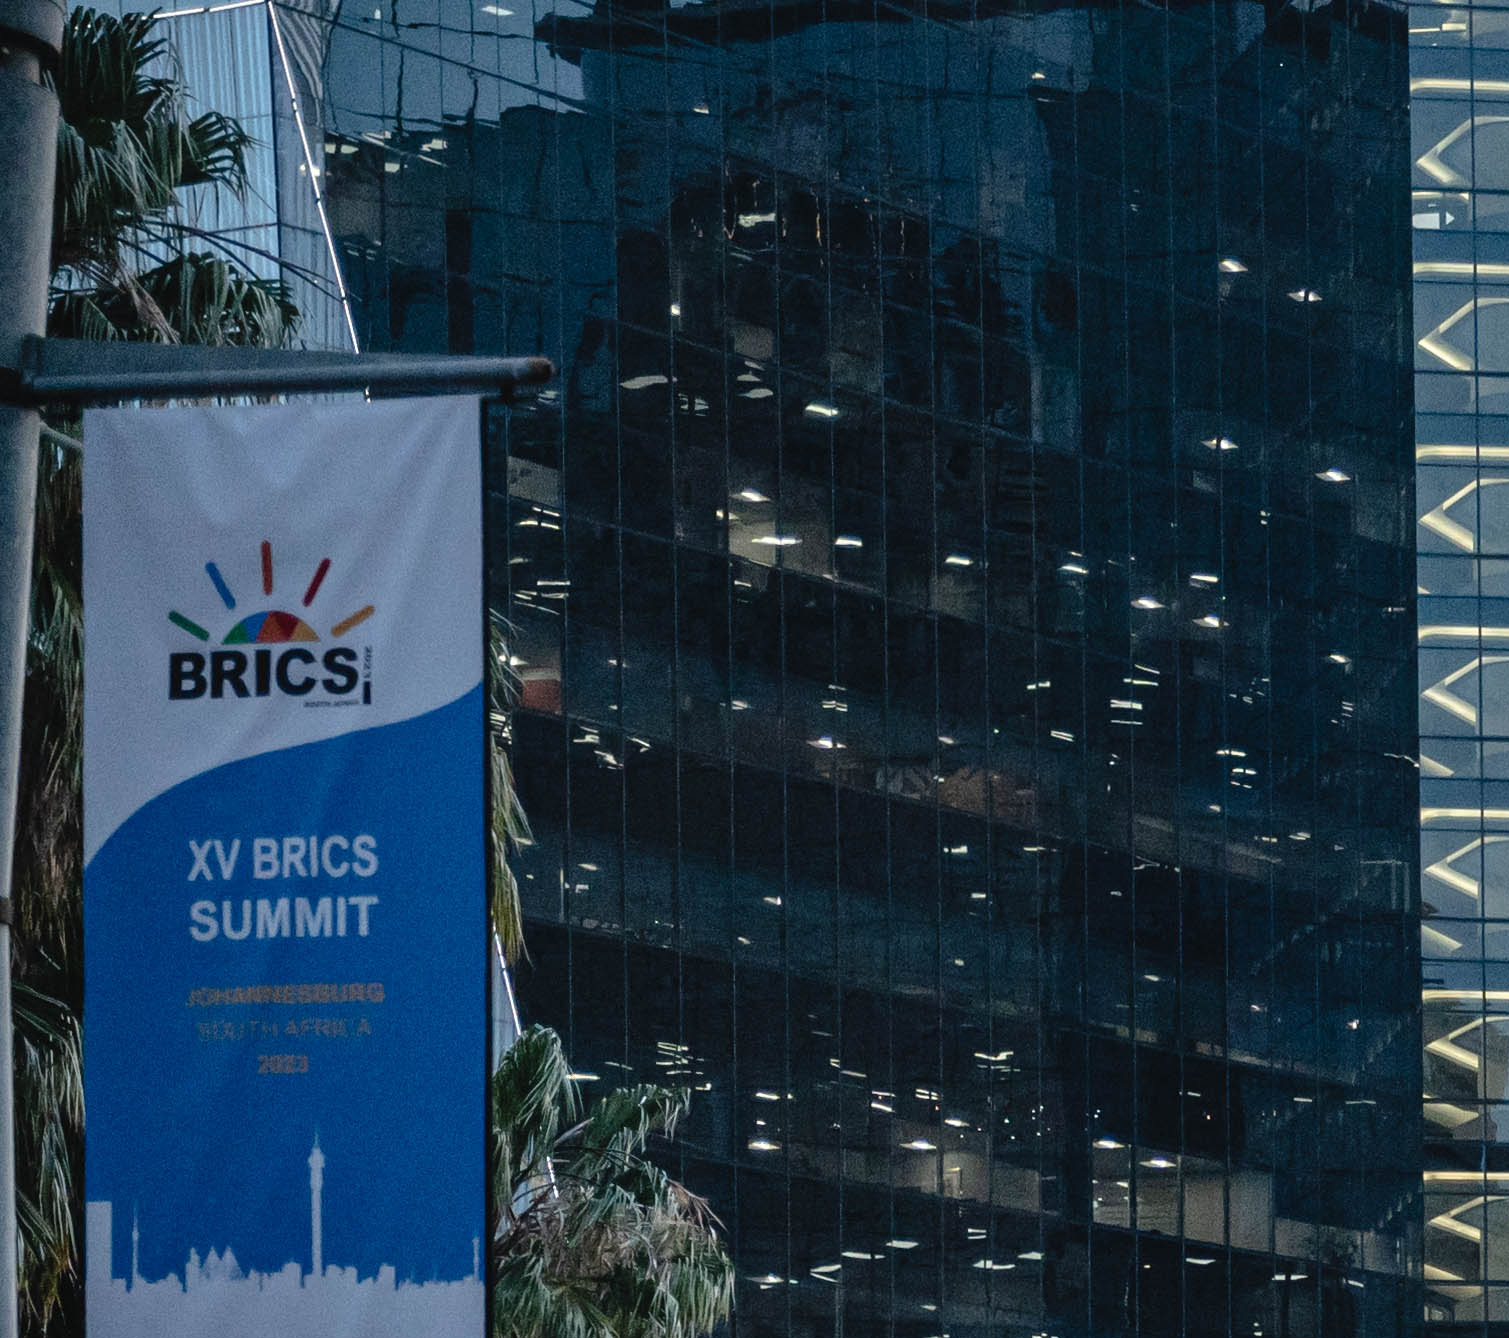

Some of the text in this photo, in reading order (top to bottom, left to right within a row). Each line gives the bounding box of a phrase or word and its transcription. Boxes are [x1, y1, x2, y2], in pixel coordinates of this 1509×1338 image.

[169, 647, 359, 700] BRICS
[187, 835, 379, 882] XV BRICS
[189, 896, 380, 942] SUMMIT
